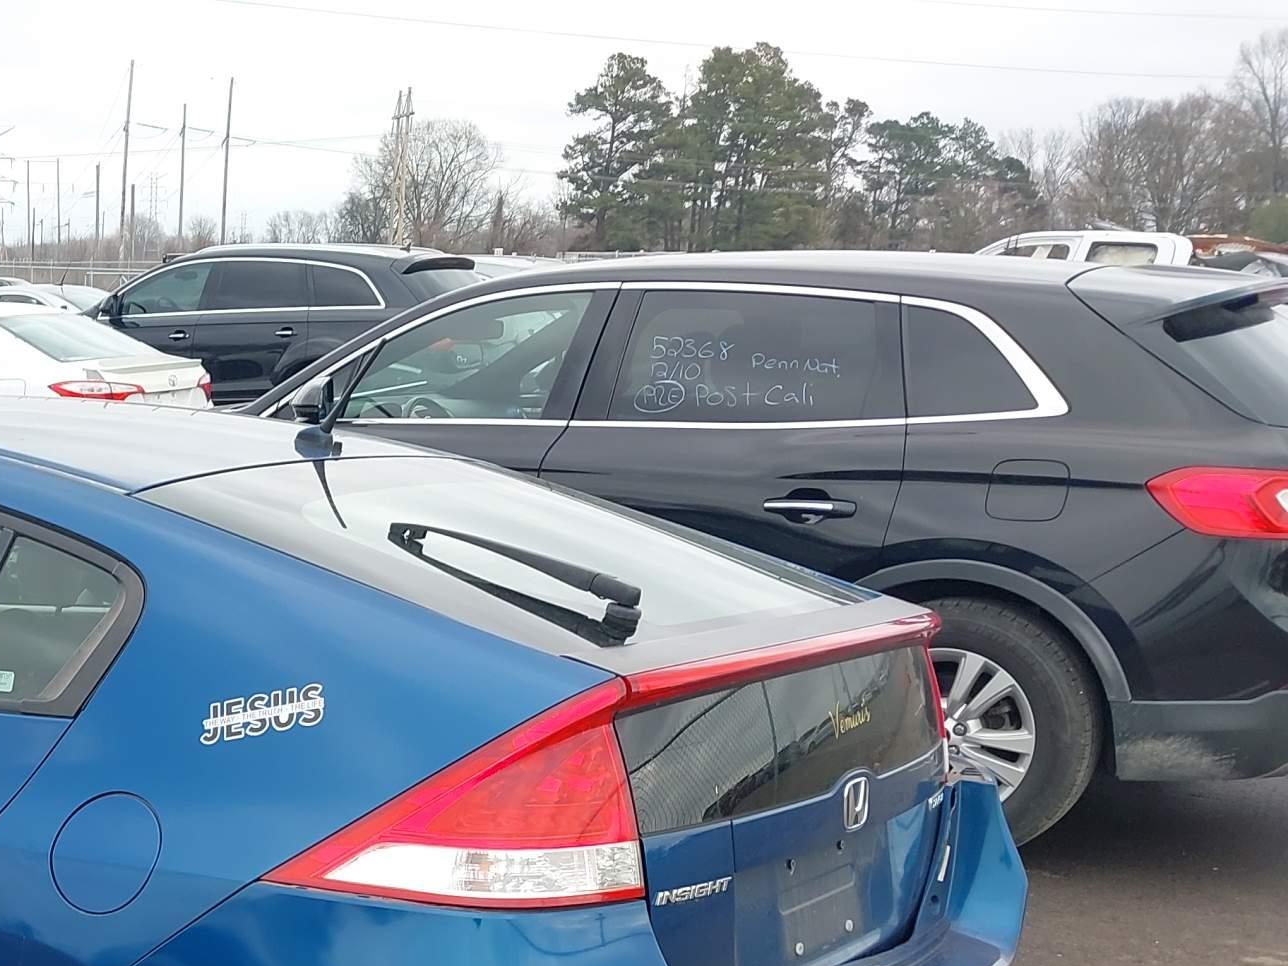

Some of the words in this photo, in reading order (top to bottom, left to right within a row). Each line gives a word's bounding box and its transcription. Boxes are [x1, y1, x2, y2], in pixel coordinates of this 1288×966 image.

[650, 336, 736, 361] 52368
[751, 352, 799, 370] Penn
[650, 361, 702, 382] 12/10
[764, 382, 815, 407] Cali
[199, 683, 323, 745] JESUS
[654, 876, 733, 907] INSIGHT
